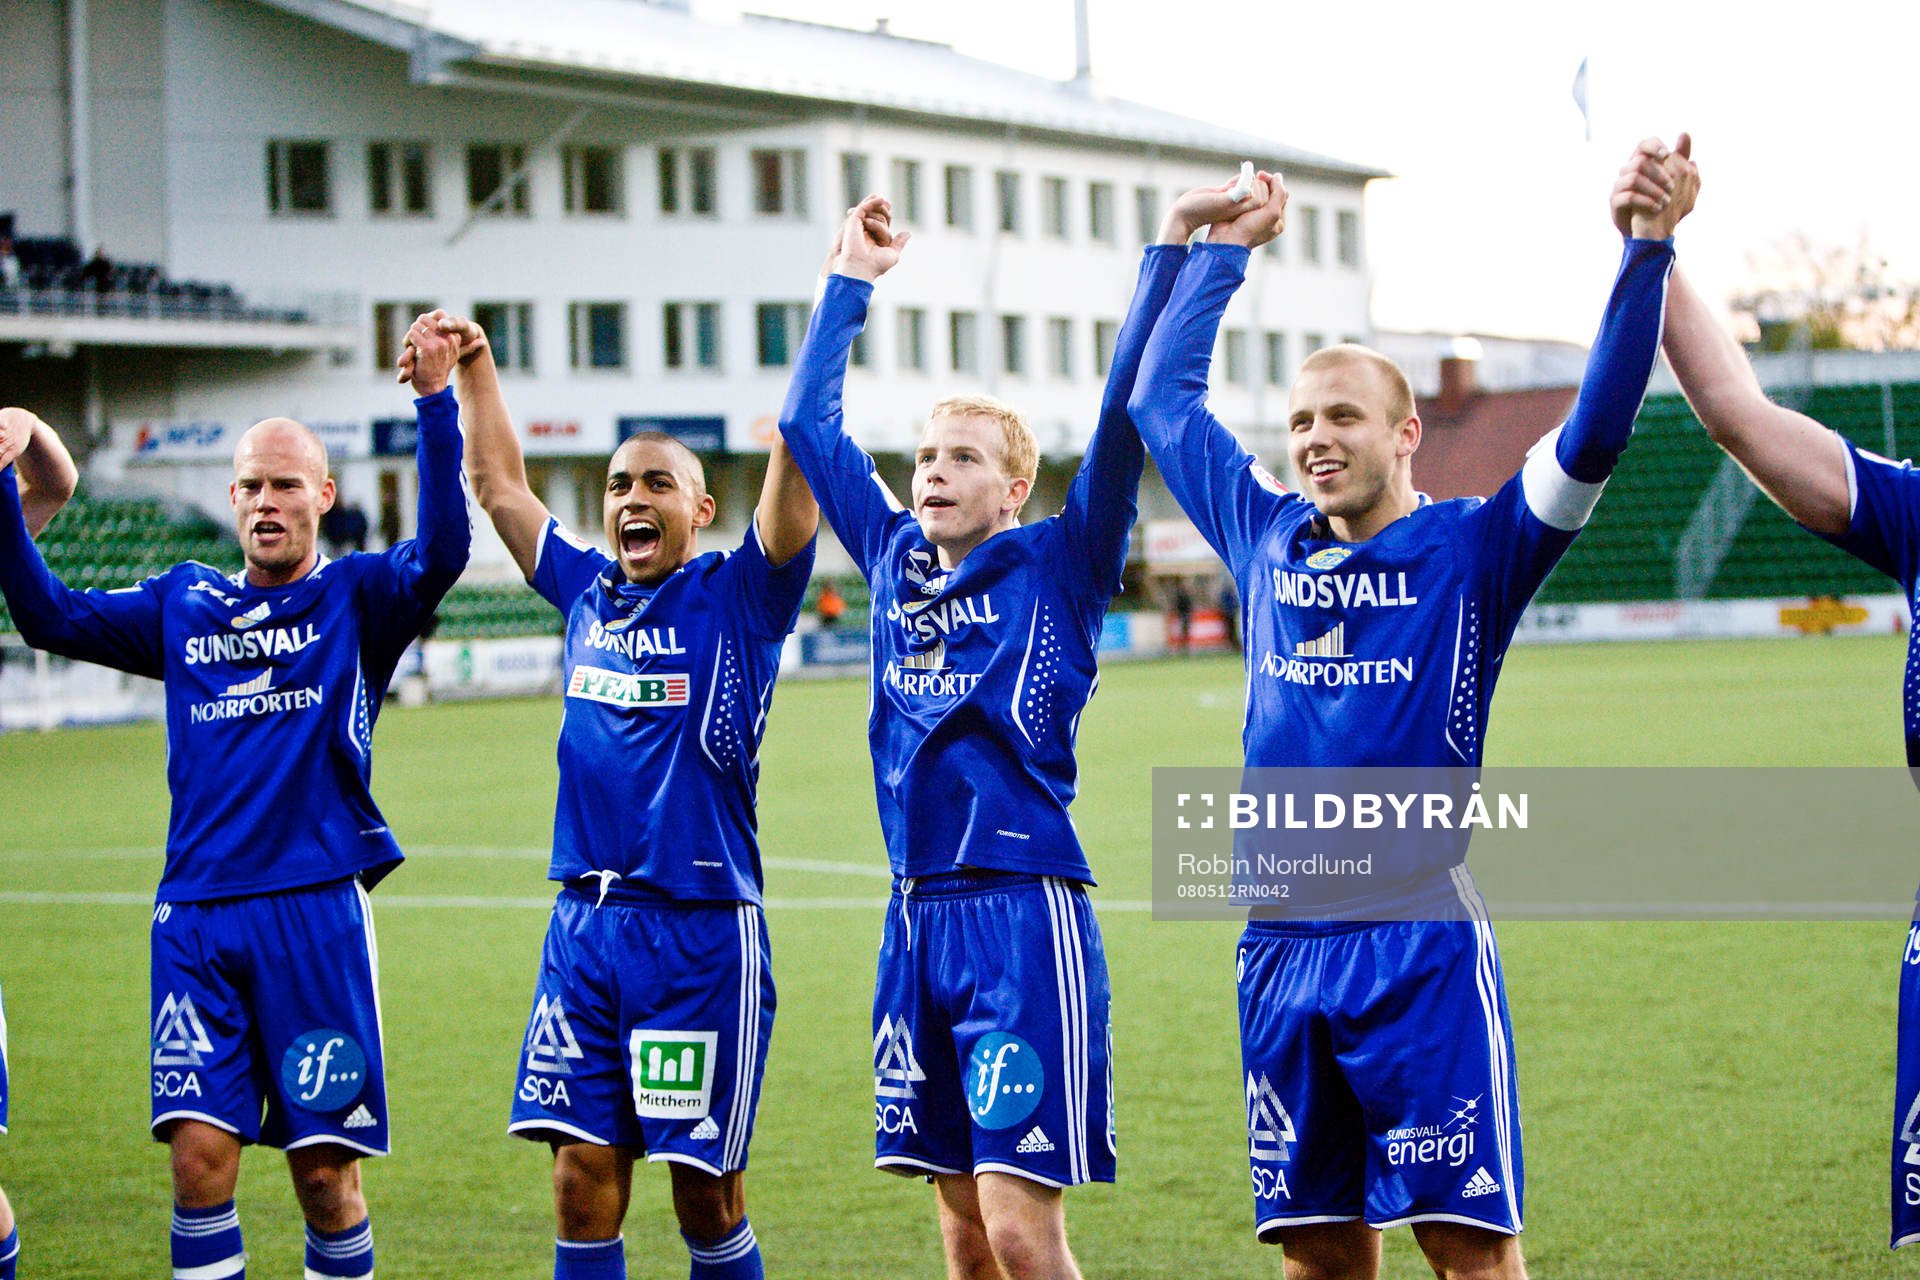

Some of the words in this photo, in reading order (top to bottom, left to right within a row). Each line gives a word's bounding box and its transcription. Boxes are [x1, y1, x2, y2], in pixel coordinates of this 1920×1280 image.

[1273, 568, 1418, 608] SUNDSVALL
[184, 623, 321, 665] SUNDSVALL
[1259, 650, 1413, 687] NORRPORTEN
[580, 671, 667, 703] PEAB
[191, 684, 324, 725] NORRPORTEN
[154, 1071, 202, 1098] SCA
[519, 1075, 571, 1107] SCA
[640, 1092, 702, 1108] Mitthem
[1016, 1142, 1055, 1153] adidas
[1386, 1125, 1443, 1141] SUNDSVALL
[1387, 1131, 1474, 1167] energi
[1252, 1166, 1292, 1200] SCA
[1461, 1183, 1501, 1198] adidas
